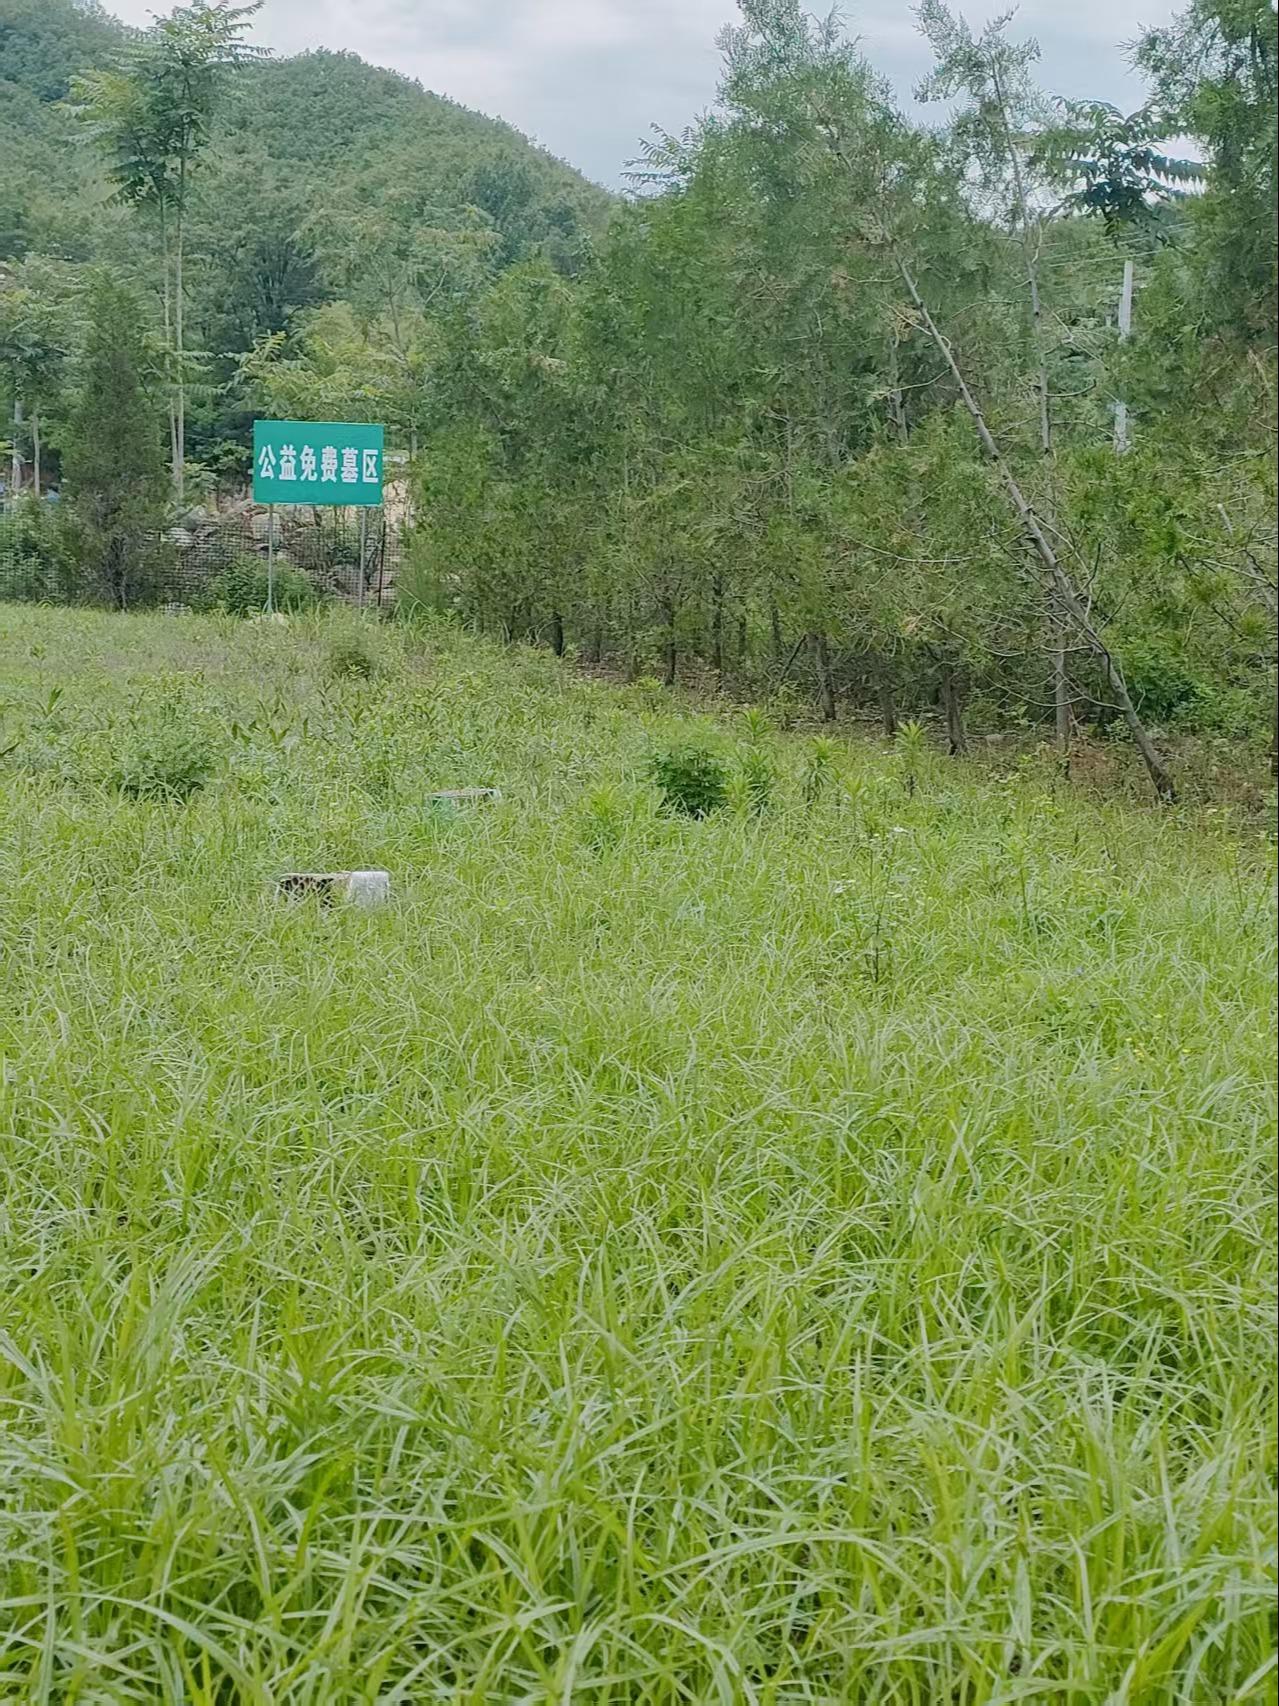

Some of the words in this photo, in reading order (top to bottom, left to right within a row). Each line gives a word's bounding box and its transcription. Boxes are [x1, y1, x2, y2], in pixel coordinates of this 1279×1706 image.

[257, 443, 379, 483] 公益免费墓区
